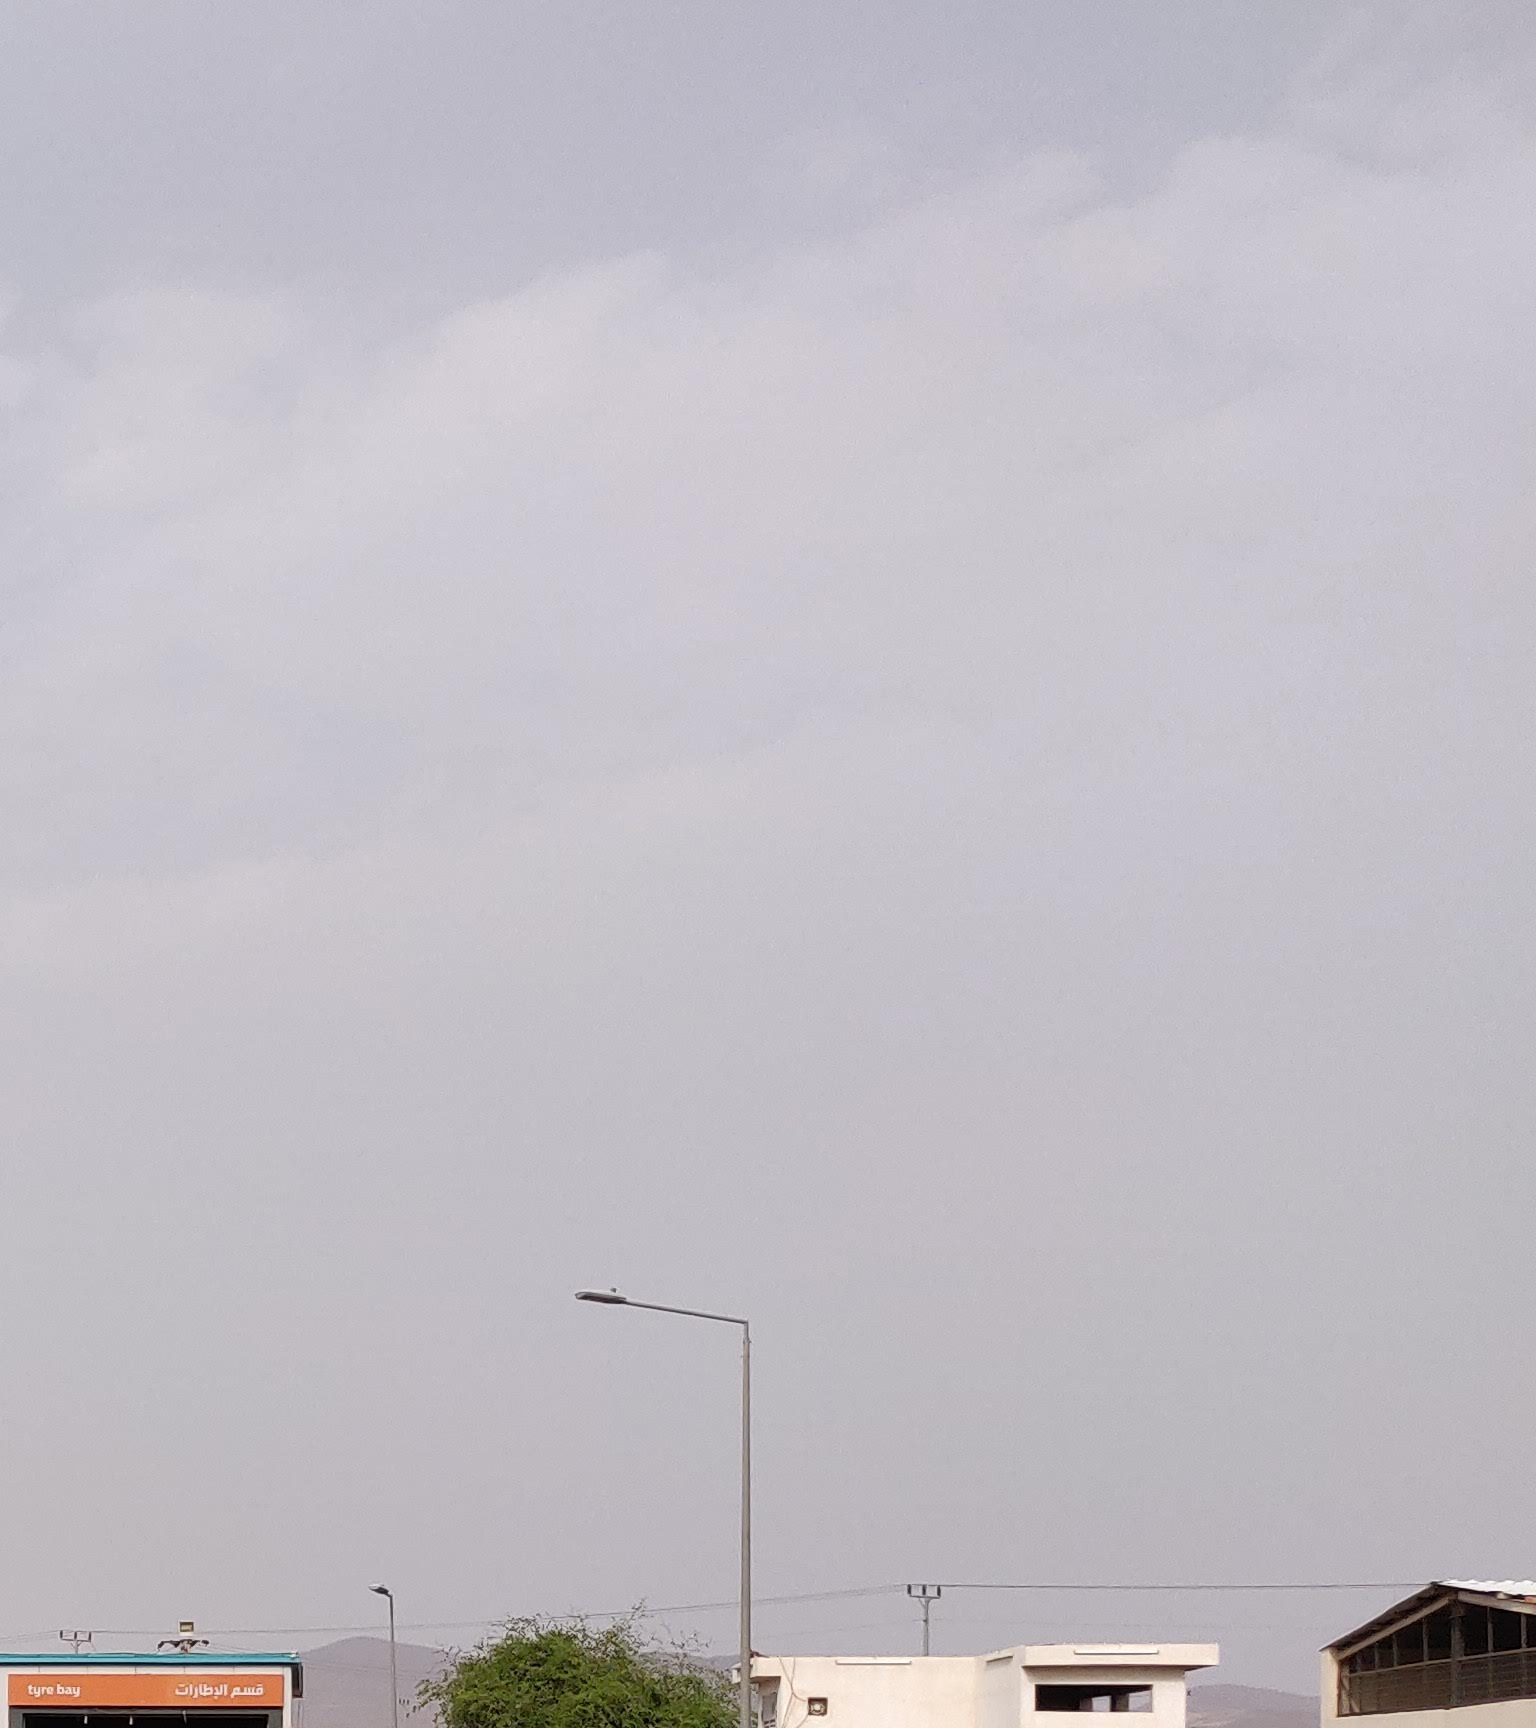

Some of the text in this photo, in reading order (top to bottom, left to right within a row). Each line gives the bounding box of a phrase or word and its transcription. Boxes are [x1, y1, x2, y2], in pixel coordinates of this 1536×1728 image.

[27, 1683, 81, 1698] tyre bay
[229, 1683, 264, 1699] قسم
